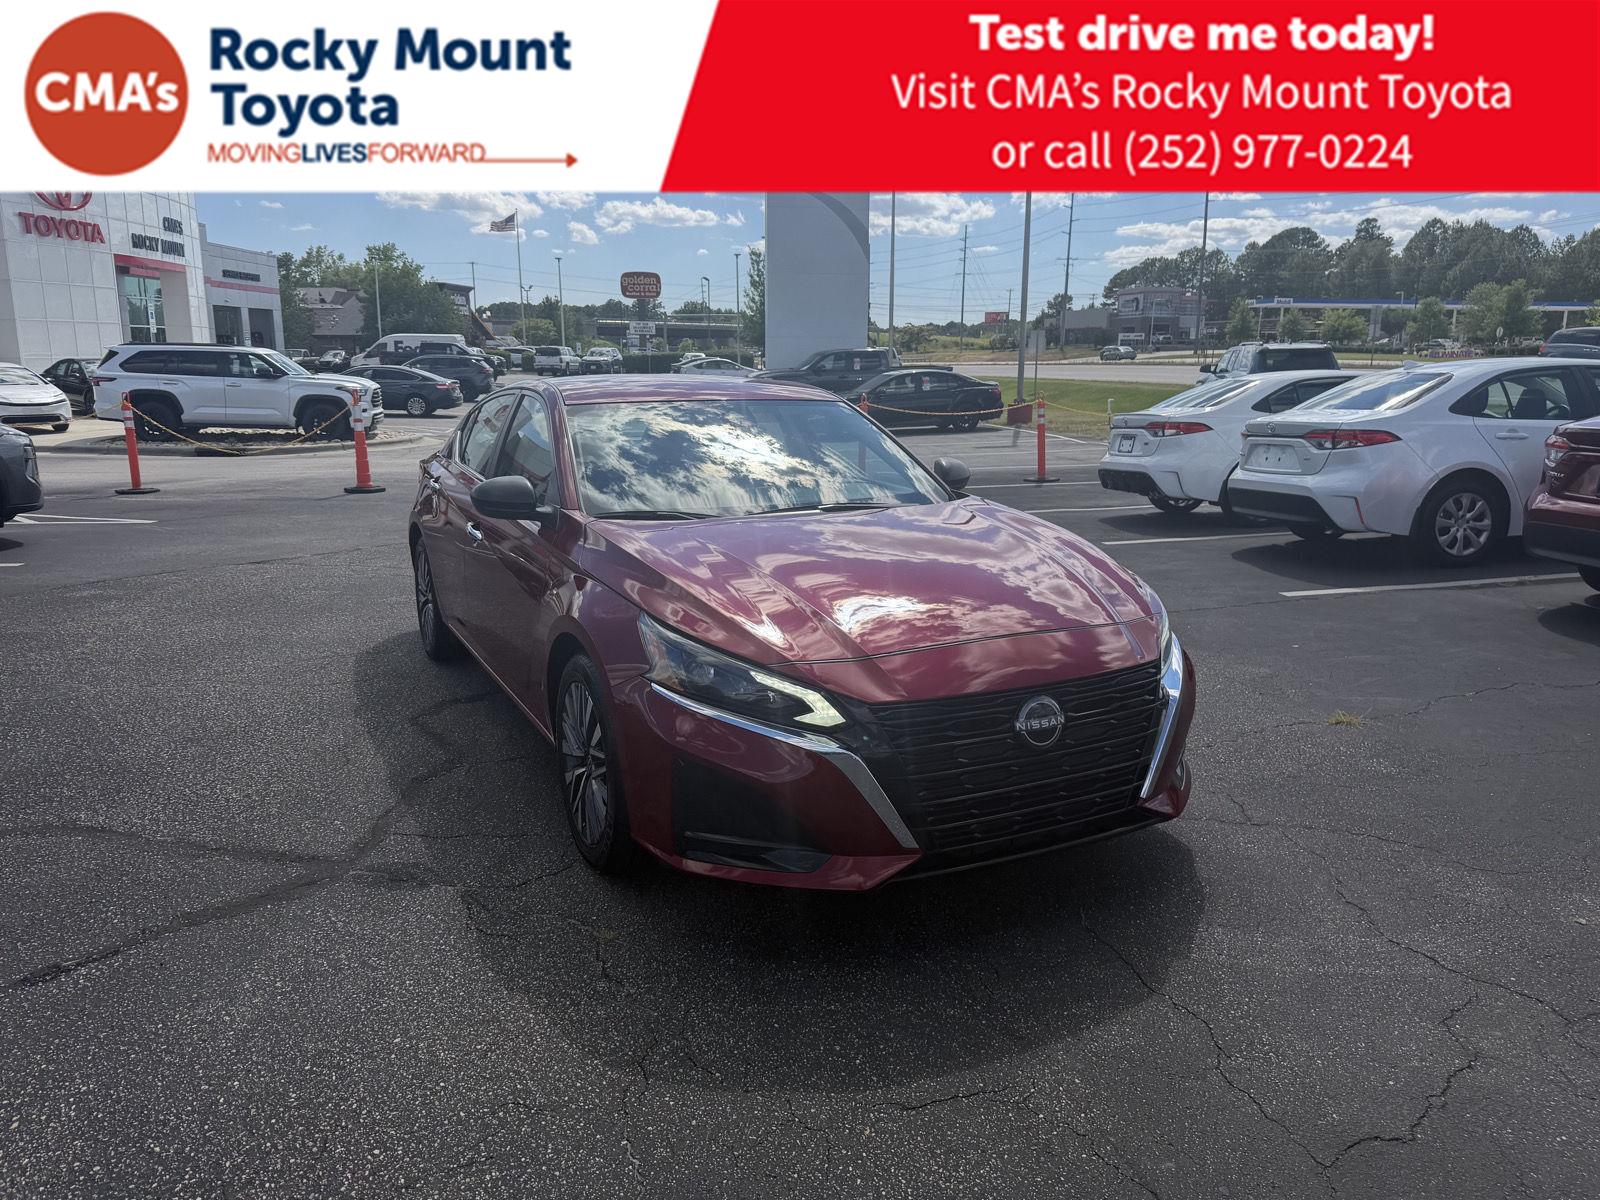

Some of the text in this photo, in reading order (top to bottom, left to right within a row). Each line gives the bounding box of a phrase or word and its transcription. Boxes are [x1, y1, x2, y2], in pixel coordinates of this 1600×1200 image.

[18, 211, 106, 244] TOYOTA
[131, 232, 160, 252] ROCKY
[621, 275, 657, 286] golden
[627, 283, 661, 292] corral
[1016, 715, 1065, 731] NISSAN
